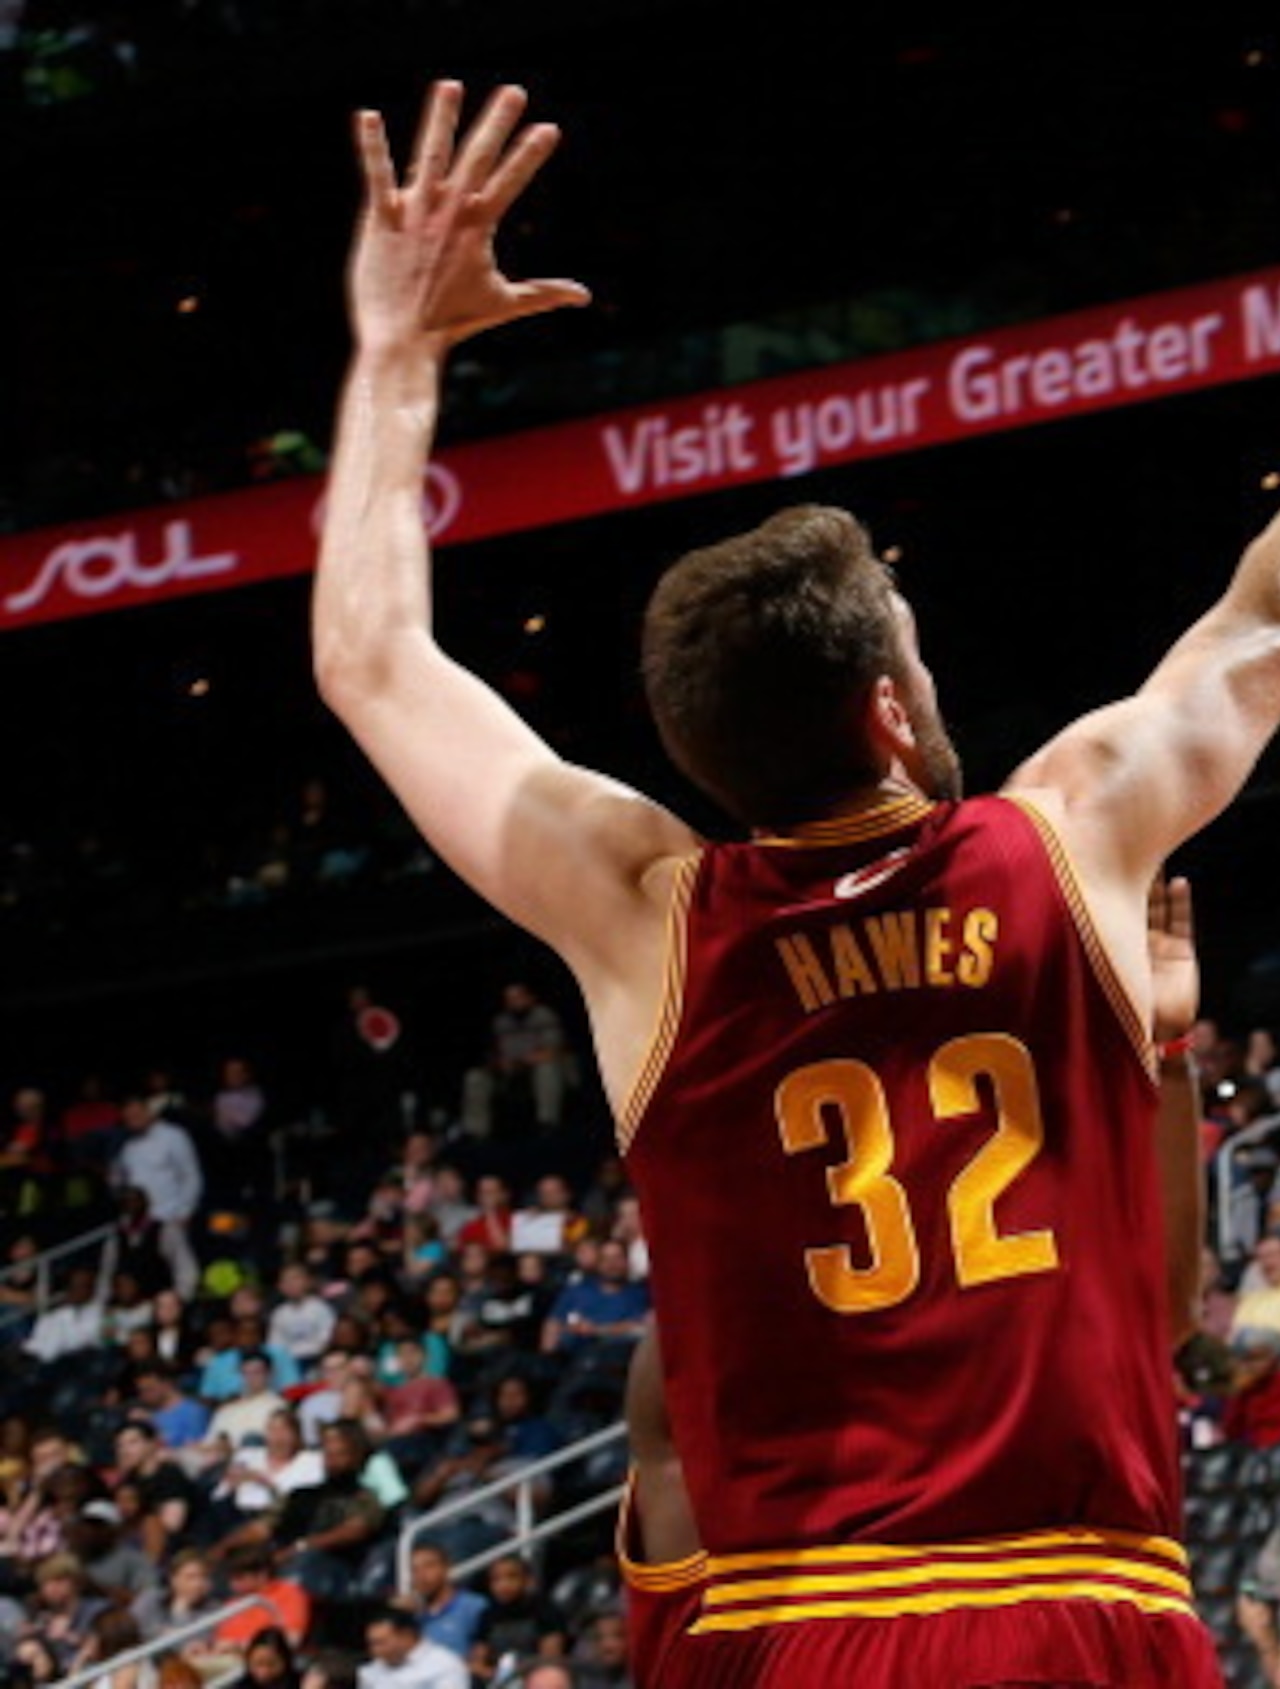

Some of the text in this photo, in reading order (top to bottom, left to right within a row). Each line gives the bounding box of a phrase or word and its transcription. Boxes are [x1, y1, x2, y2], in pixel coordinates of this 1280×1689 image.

[602, 402, 755, 494] Visit
[769, 376, 929, 477] your
[947, 310, 1222, 422] Greater
[774, 907, 999, 1014] HAWES
[773, 1031, 1060, 1315] 32
